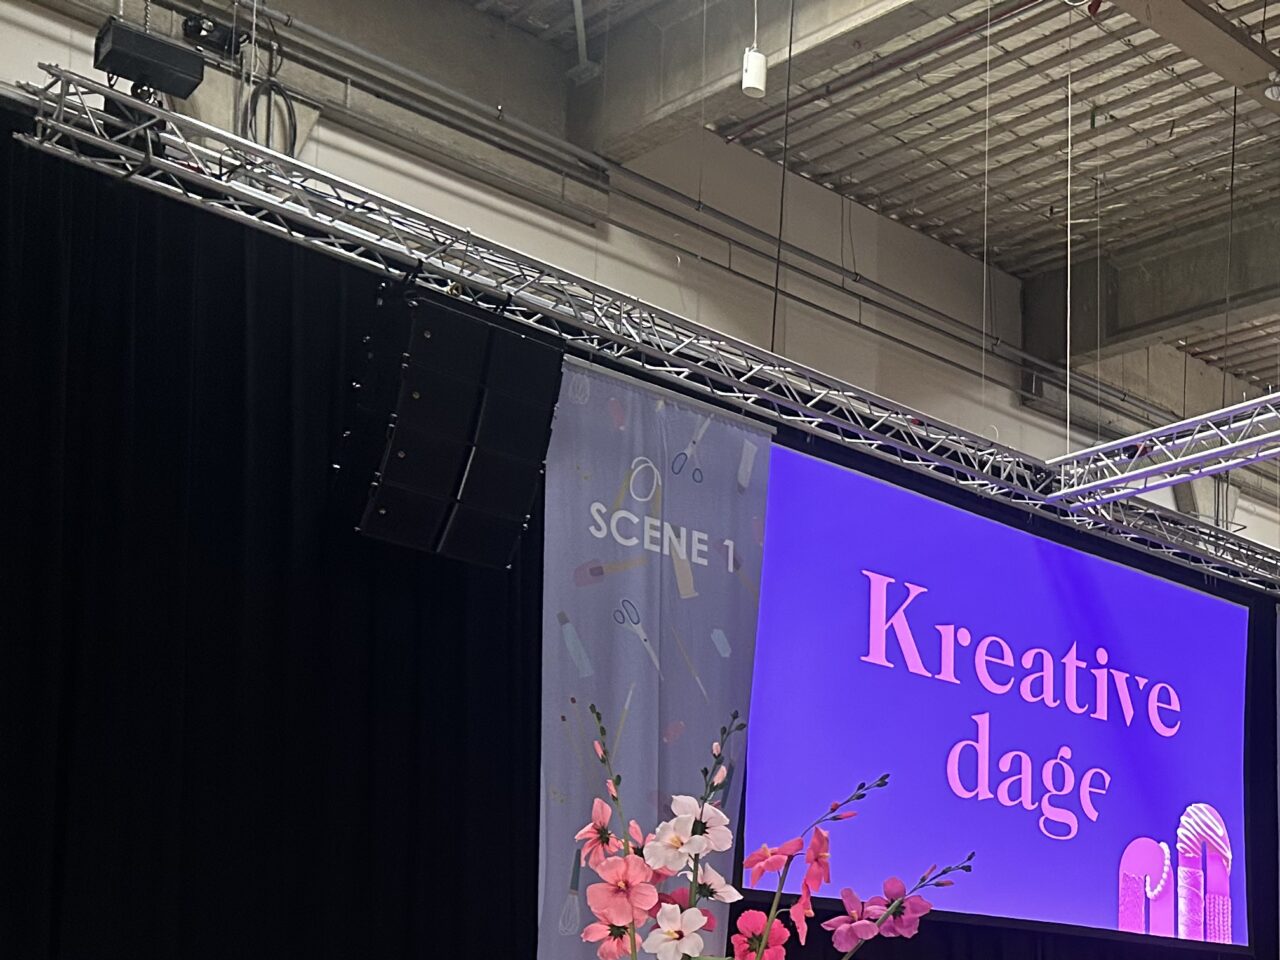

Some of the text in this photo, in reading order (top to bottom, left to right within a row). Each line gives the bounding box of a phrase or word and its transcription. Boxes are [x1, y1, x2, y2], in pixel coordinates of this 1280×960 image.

[589, 501, 735, 573] SCENE 1
[859, 569, 1182, 738] Kreative
[946, 712, 1112, 841] dage
